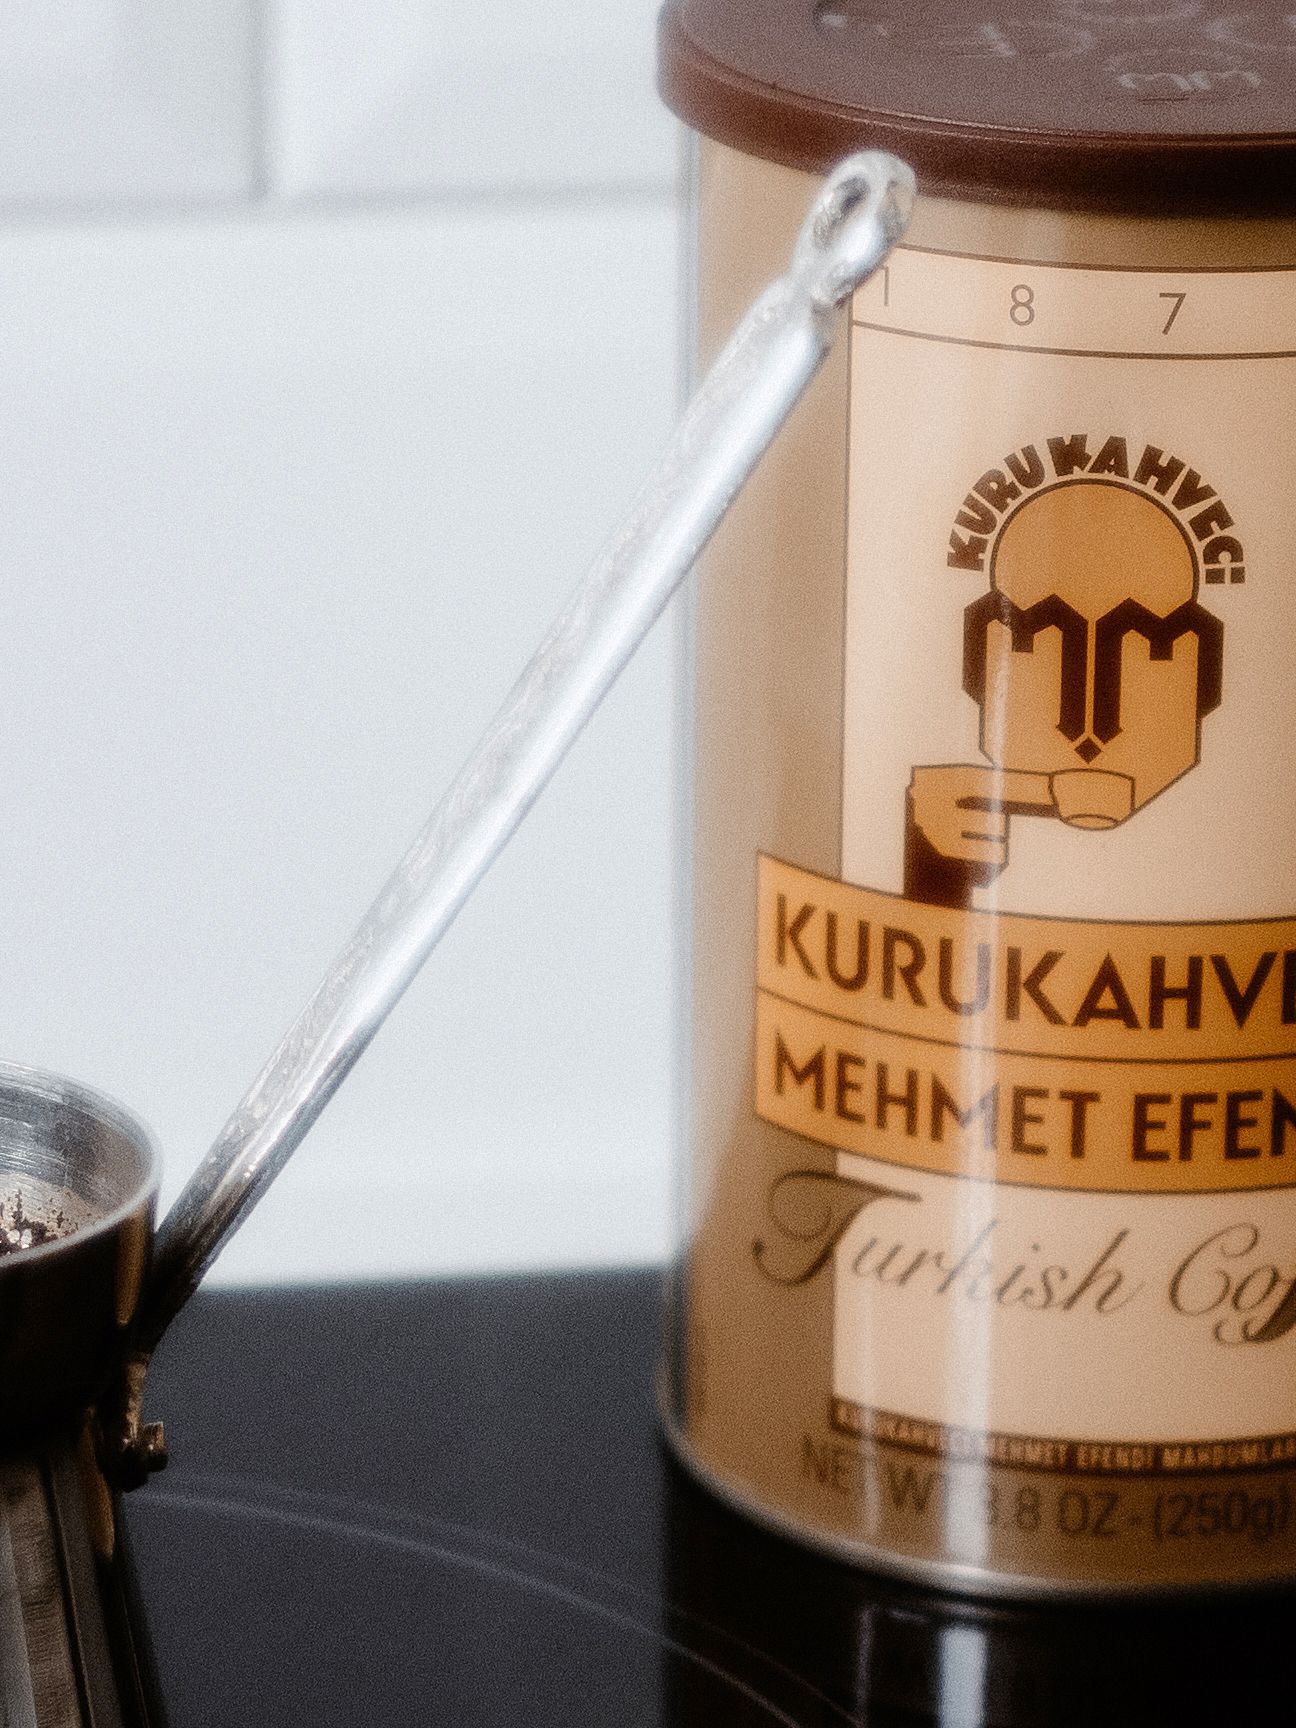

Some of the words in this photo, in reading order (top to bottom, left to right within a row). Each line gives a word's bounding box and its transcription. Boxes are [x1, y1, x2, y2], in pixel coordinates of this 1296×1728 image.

[1009, 284, 1036, 326] 8
[1159, 292, 1187, 336] 7
[773, 1031, 1101, 1161] MEHMET
[751, 1171, 1146, 1315] Turkish
[1152, 1484, 1292, 1544] (250g)
